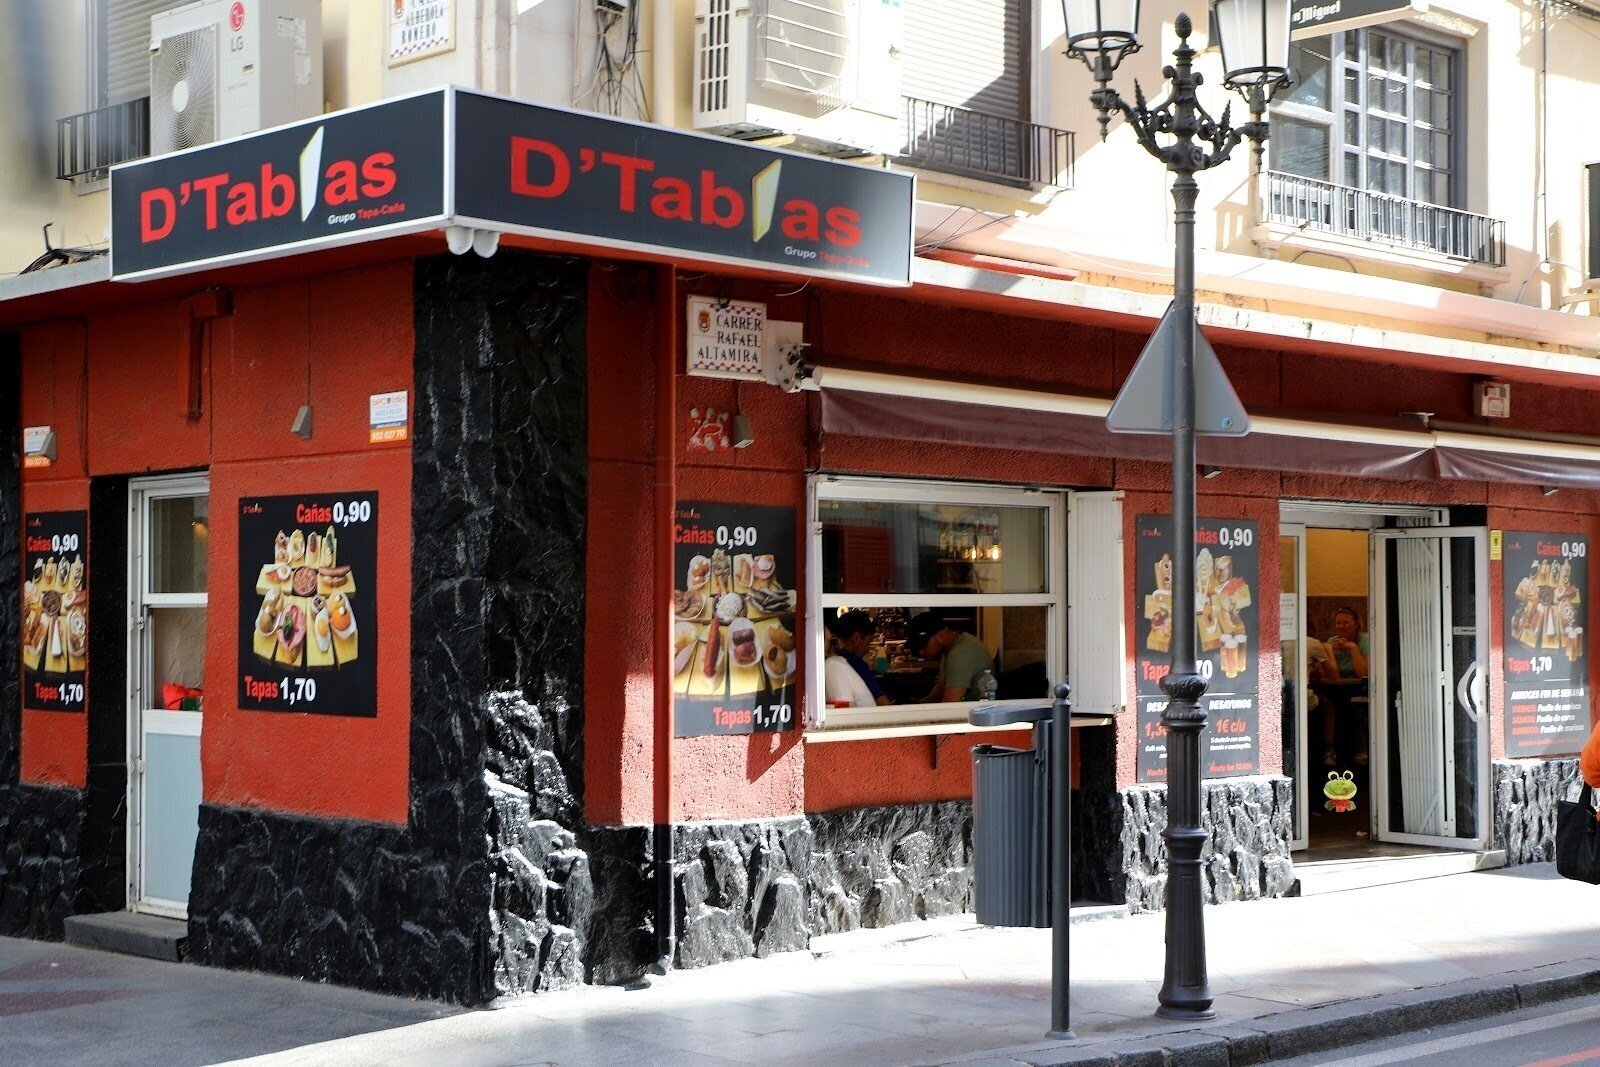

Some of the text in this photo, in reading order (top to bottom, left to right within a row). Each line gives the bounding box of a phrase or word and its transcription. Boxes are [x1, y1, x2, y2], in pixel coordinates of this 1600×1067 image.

[1299, 0, 1340, 24] Miguel
[402, 22, 436, 44] ROMERO
[231, 36, 243, 52] LG
[328, 213, 356, 225] Grupo
[784, 246, 817, 259] Grupo
[716, 314, 762, 331] CARRER
[717, 331, 760, 348] RAFAEL
[698, 346, 759, 363] ALTAMIRA
[296, 501, 371, 527] Cañas 0,90
[28, 534, 79, 555] Cañas 0,90
[717, 526, 757, 550] 0,90
[1220, 527, 1252, 549] 0,90
[1537, 541, 1560, 556] Cañas
[1562, 542, 1586, 560] 0,90
[1142, 661, 1170, 685] Tapa
[1509, 656, 1552, 675] Tapas 1,70
[35, 682, 83, 705] Tapas 1,70
[244, 676, 316, 705] Tapas 1,70
[1209, 699, 1251, 711] DESAYUNOS
[713, 704, 791, 729] Tapas 1,70
